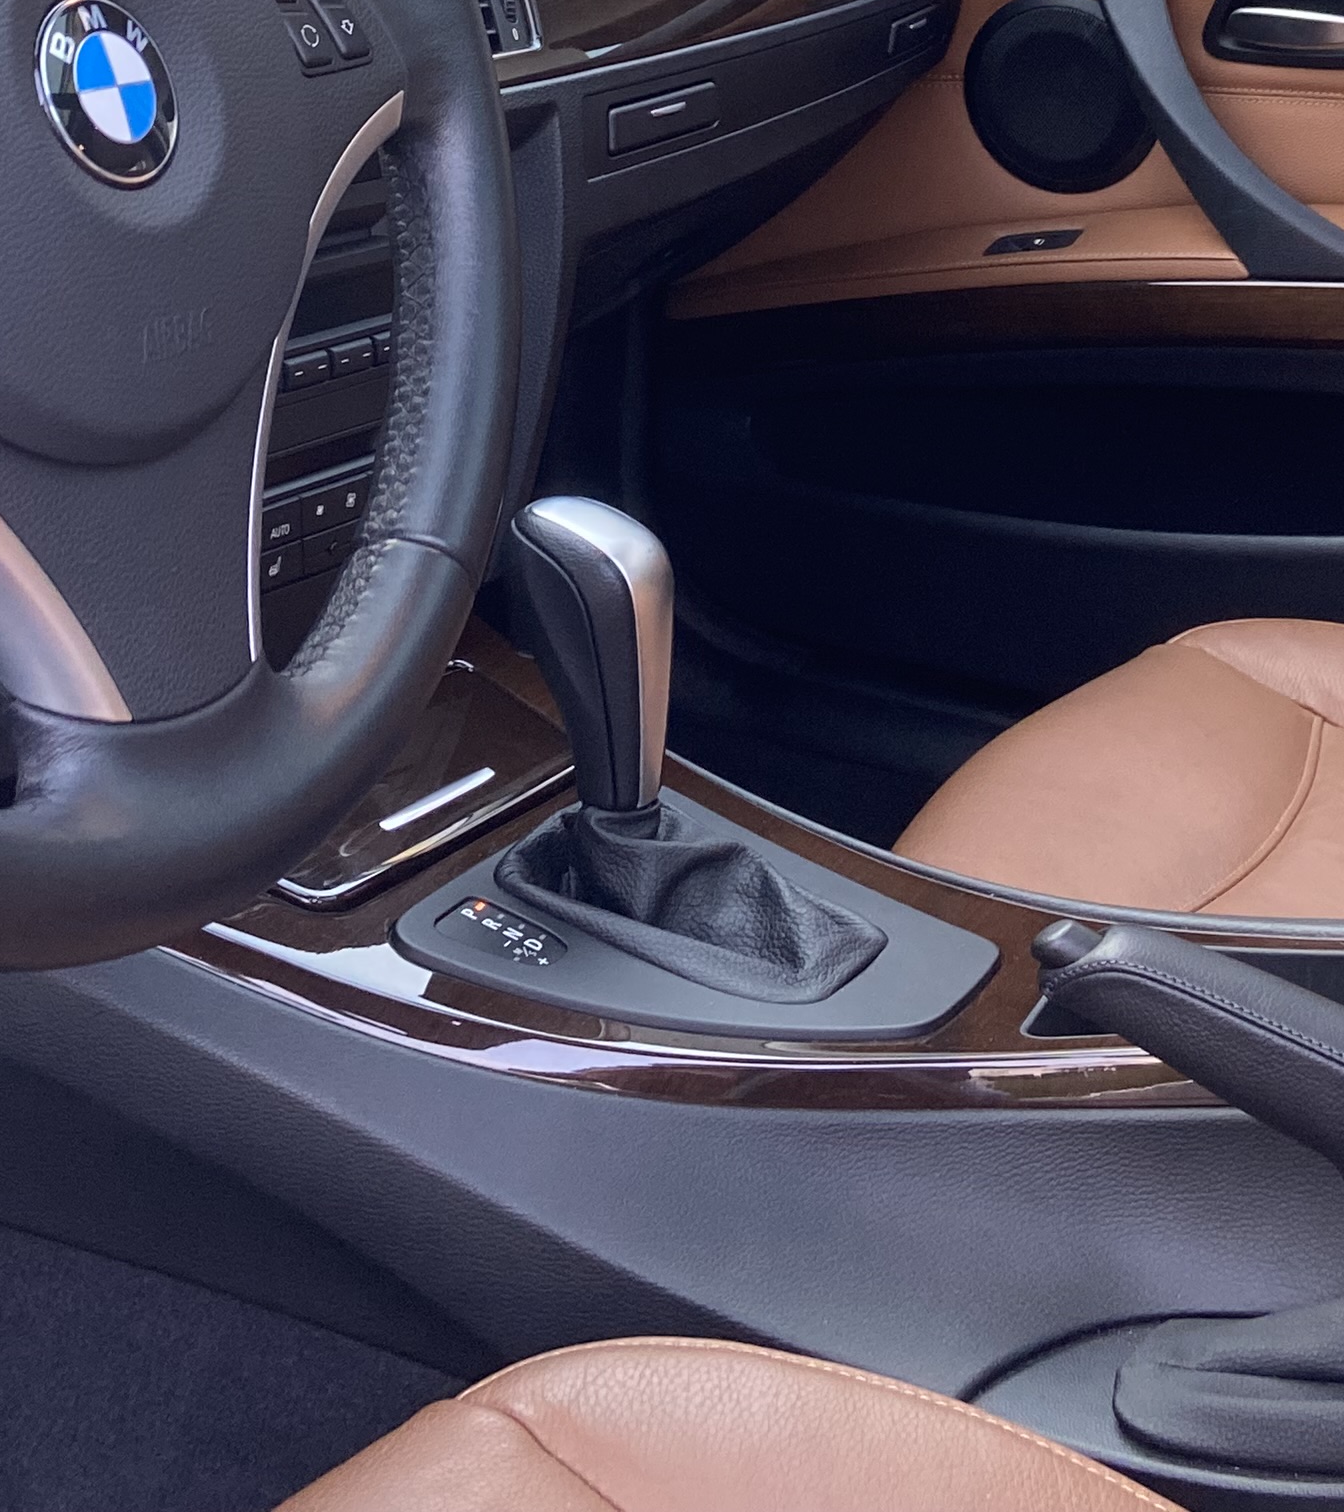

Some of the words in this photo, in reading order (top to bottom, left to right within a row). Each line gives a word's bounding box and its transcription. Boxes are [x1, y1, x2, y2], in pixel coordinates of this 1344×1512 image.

[49, 4, 149, 59] BMW
[270, 523, 290, 540] AUTO
[460, 908, 478, 920] P
[481, 917, 502, 931] R
[502, 927, 524, 940] N
[523, 938, 543, 952] D
